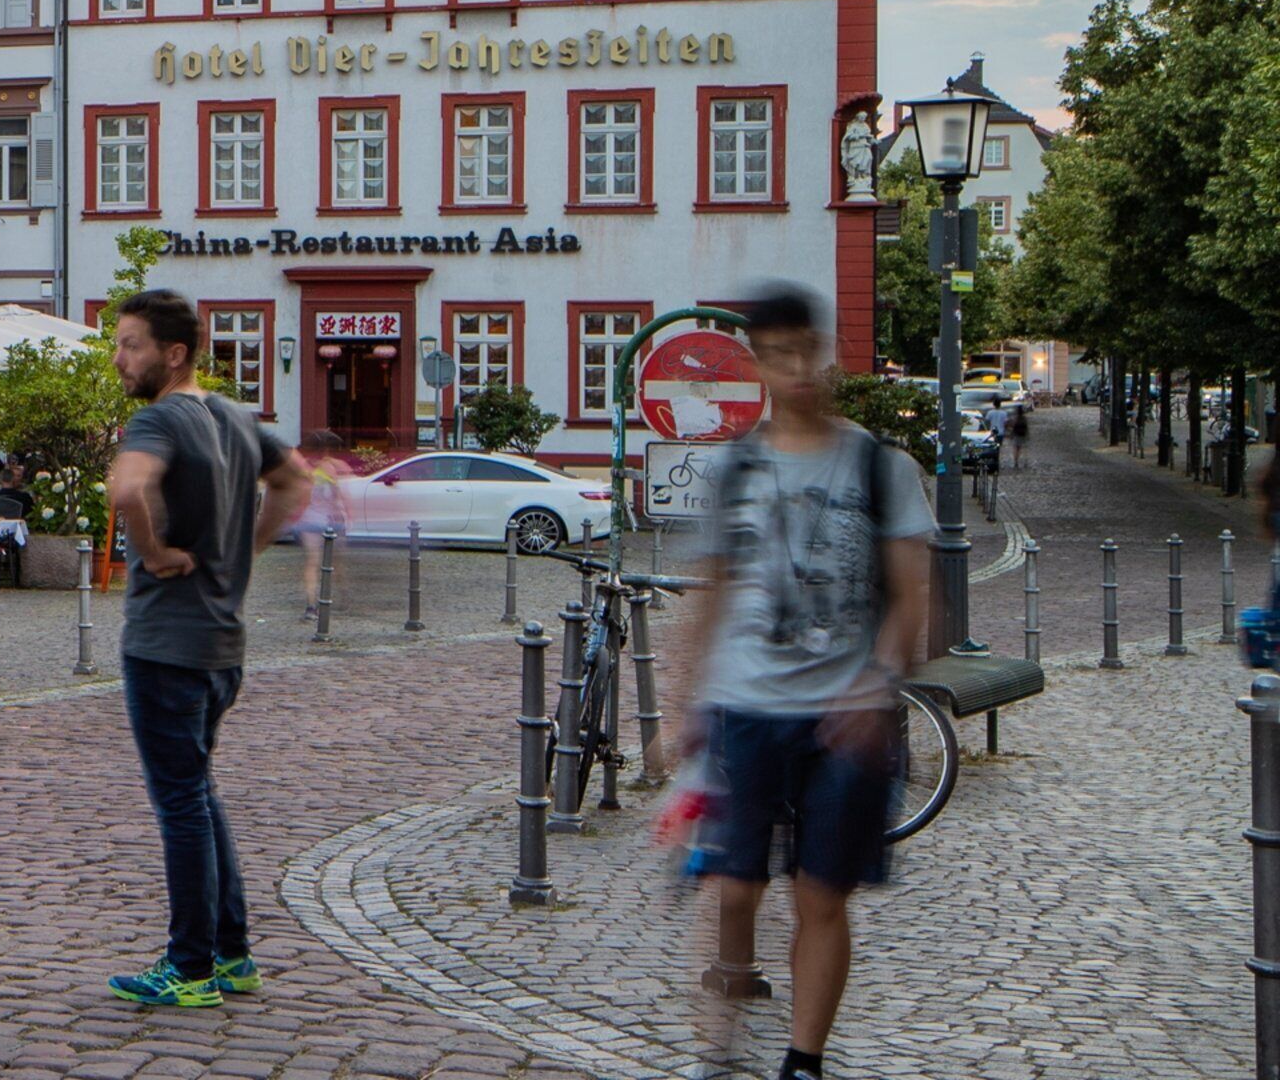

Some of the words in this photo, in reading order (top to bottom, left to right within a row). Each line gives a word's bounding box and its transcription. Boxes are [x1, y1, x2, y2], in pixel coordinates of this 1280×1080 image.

[153, 41, 265, 85] Hotel
[287, 24, 735, 76] Vier-Jahreszeiten
[490, 227, 582, 255] Asia
